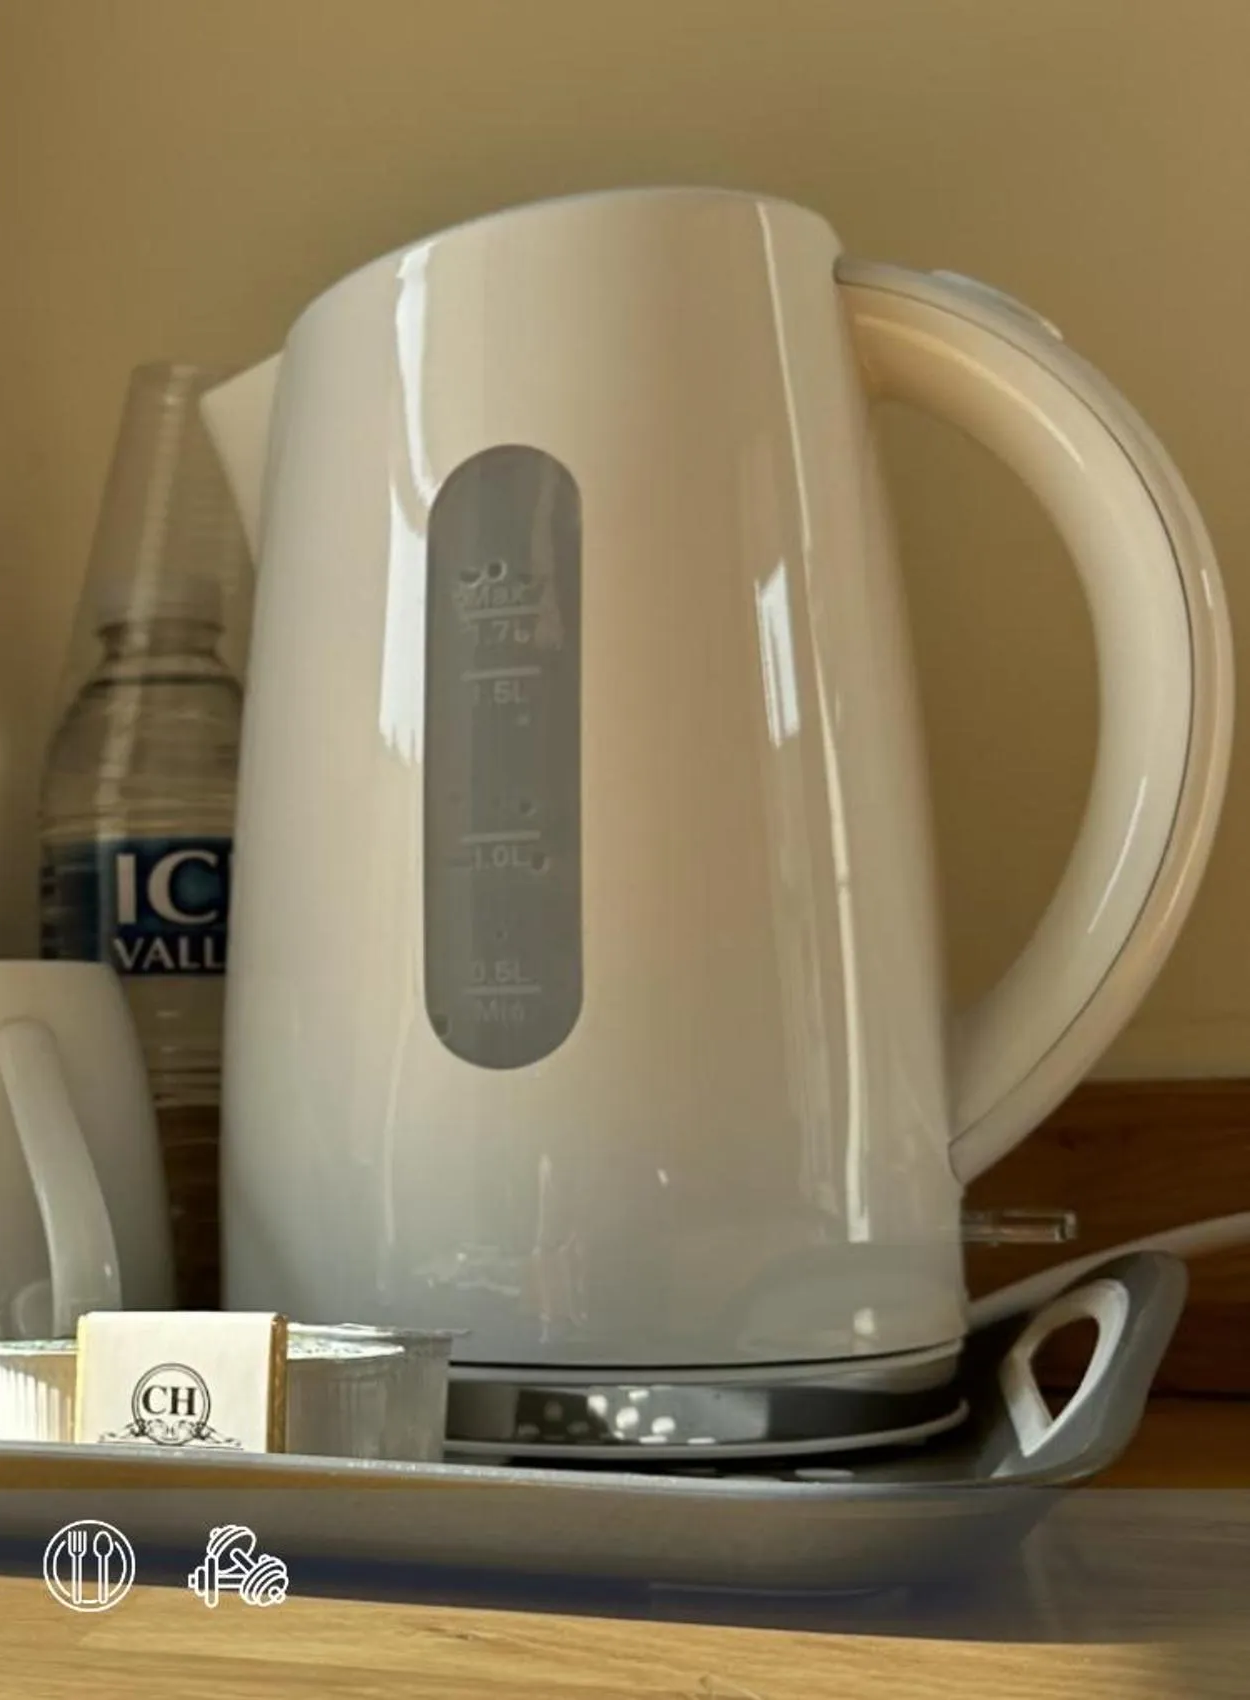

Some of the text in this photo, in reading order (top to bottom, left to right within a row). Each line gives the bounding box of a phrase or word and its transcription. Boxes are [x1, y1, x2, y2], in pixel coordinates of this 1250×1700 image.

[474, 845, 529, 871] 1.0L
[114, 849, 231, 926] IC
[142, 1384, 196, 1416] CH
